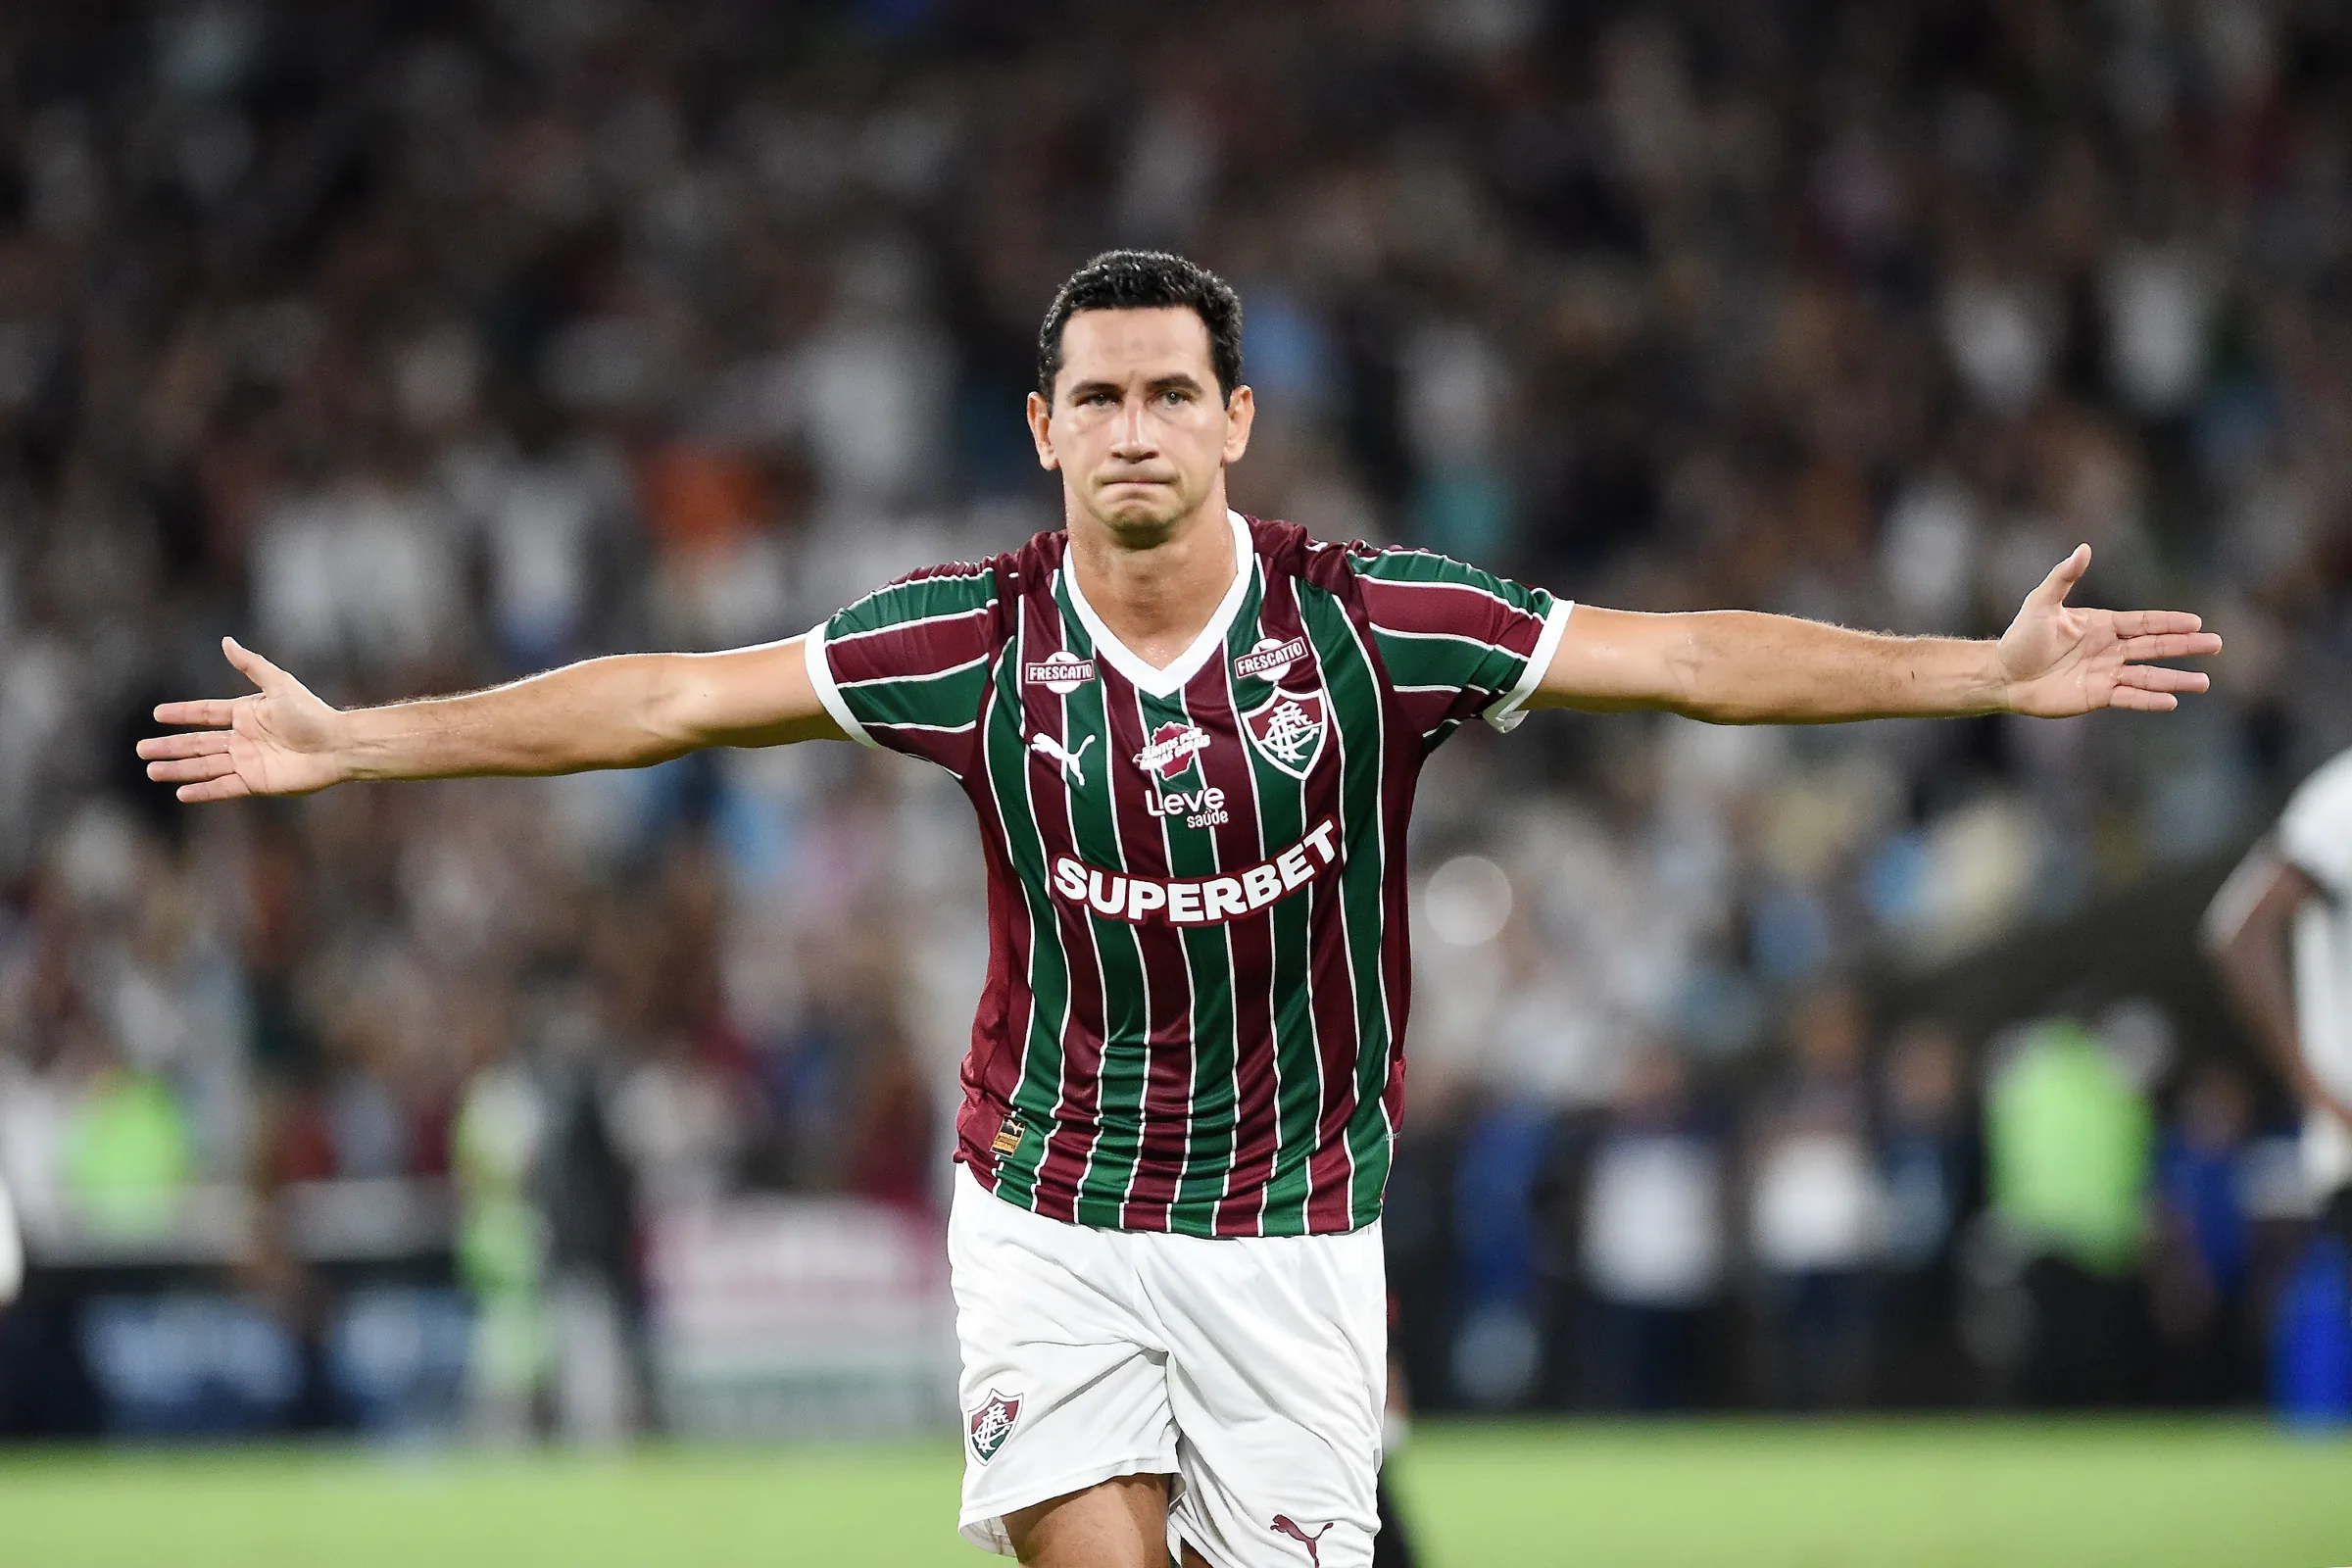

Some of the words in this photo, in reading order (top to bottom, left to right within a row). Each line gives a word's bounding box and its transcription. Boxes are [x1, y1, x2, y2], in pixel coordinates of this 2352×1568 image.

[1145, 787, 1225, 816] Leve
[1187, 809, 1229, 828] saúde
[1054, 819, 1337, 922] SUPERBET
